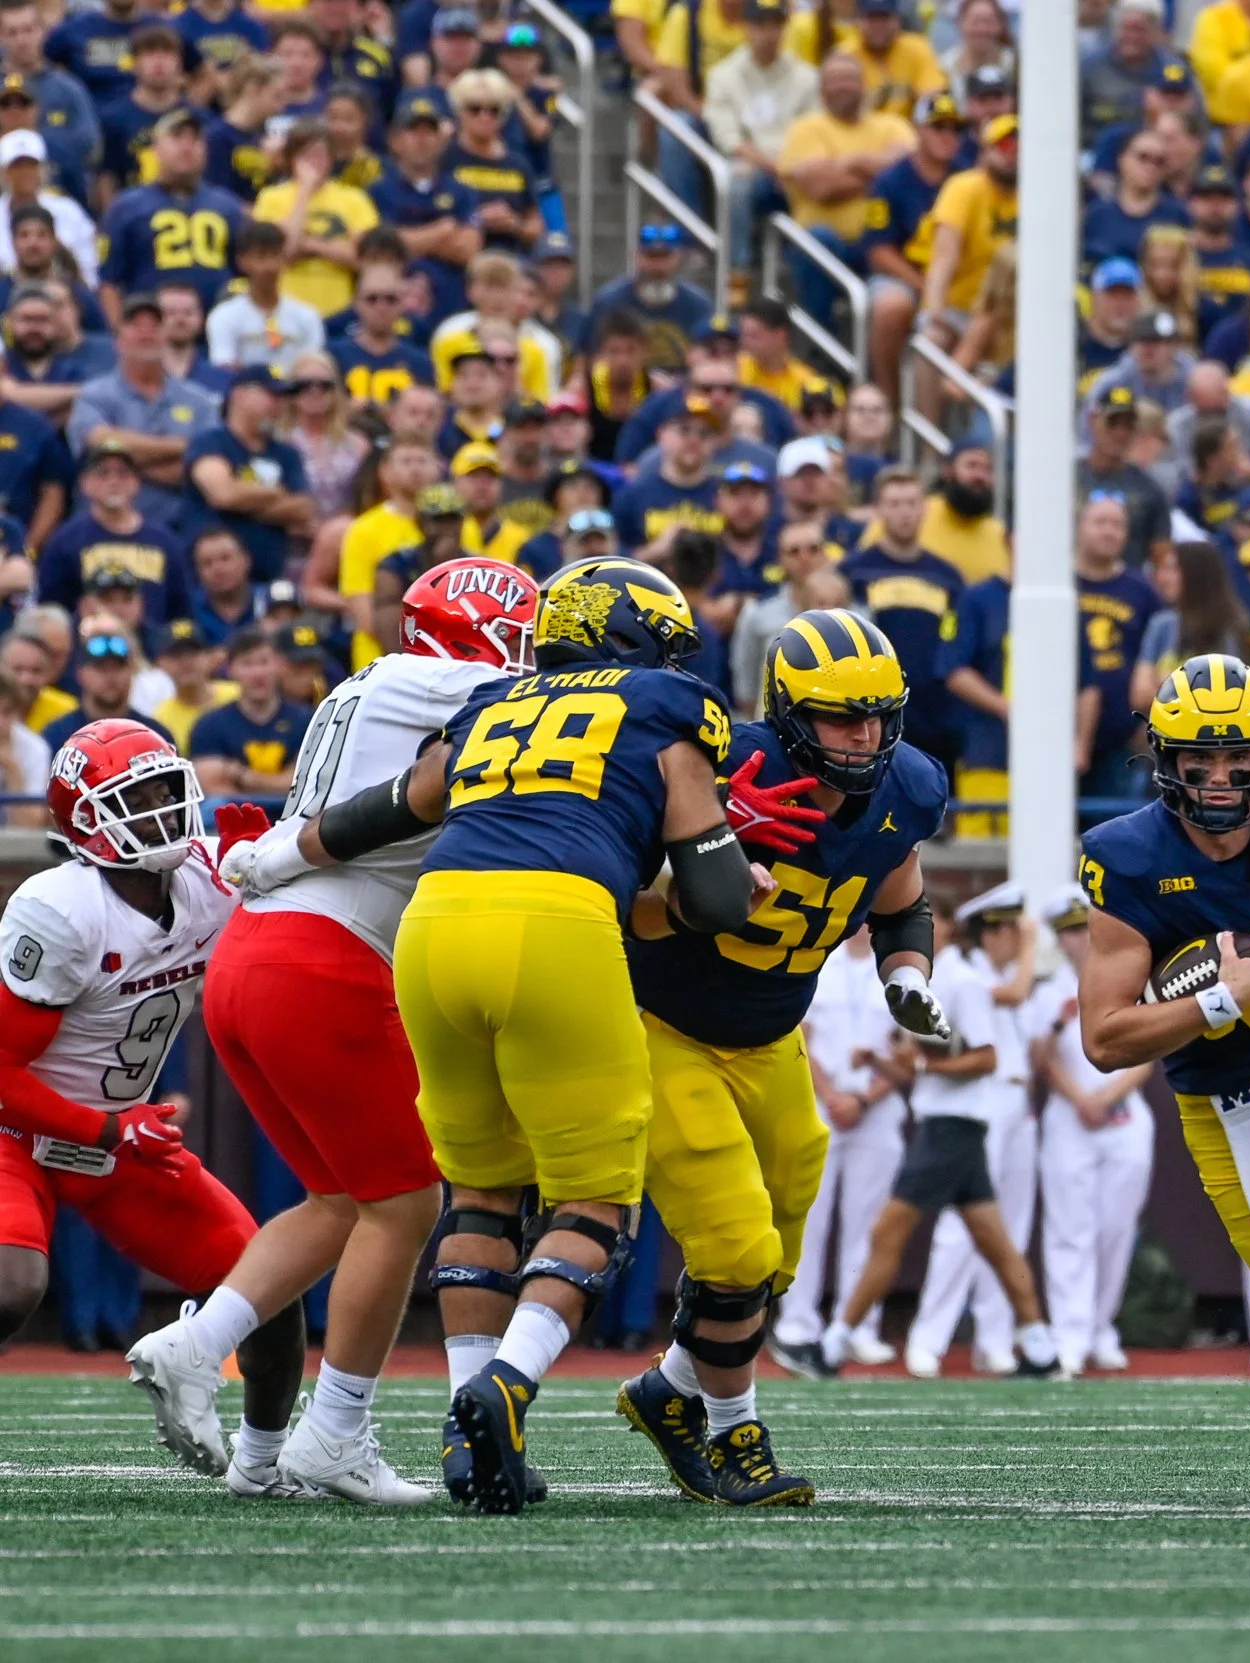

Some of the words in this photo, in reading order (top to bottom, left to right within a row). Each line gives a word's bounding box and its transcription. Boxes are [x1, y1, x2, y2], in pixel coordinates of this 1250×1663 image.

[151, 209, 229, 270] 20
[445, 568, 525, 613] UNLV
[506, 669, 631, 700] EL-HADI
[450, 693, 627, 809] 58
[714, 861, 869, 974] 51
[9, 934, 44, 982] 9
[119, 960, 206, 996] REBELS
[99, 989, 181, 1101] 9
[740, 1430, 755, 1443] M
[348, 1471, 371, 1489] ALPHA
